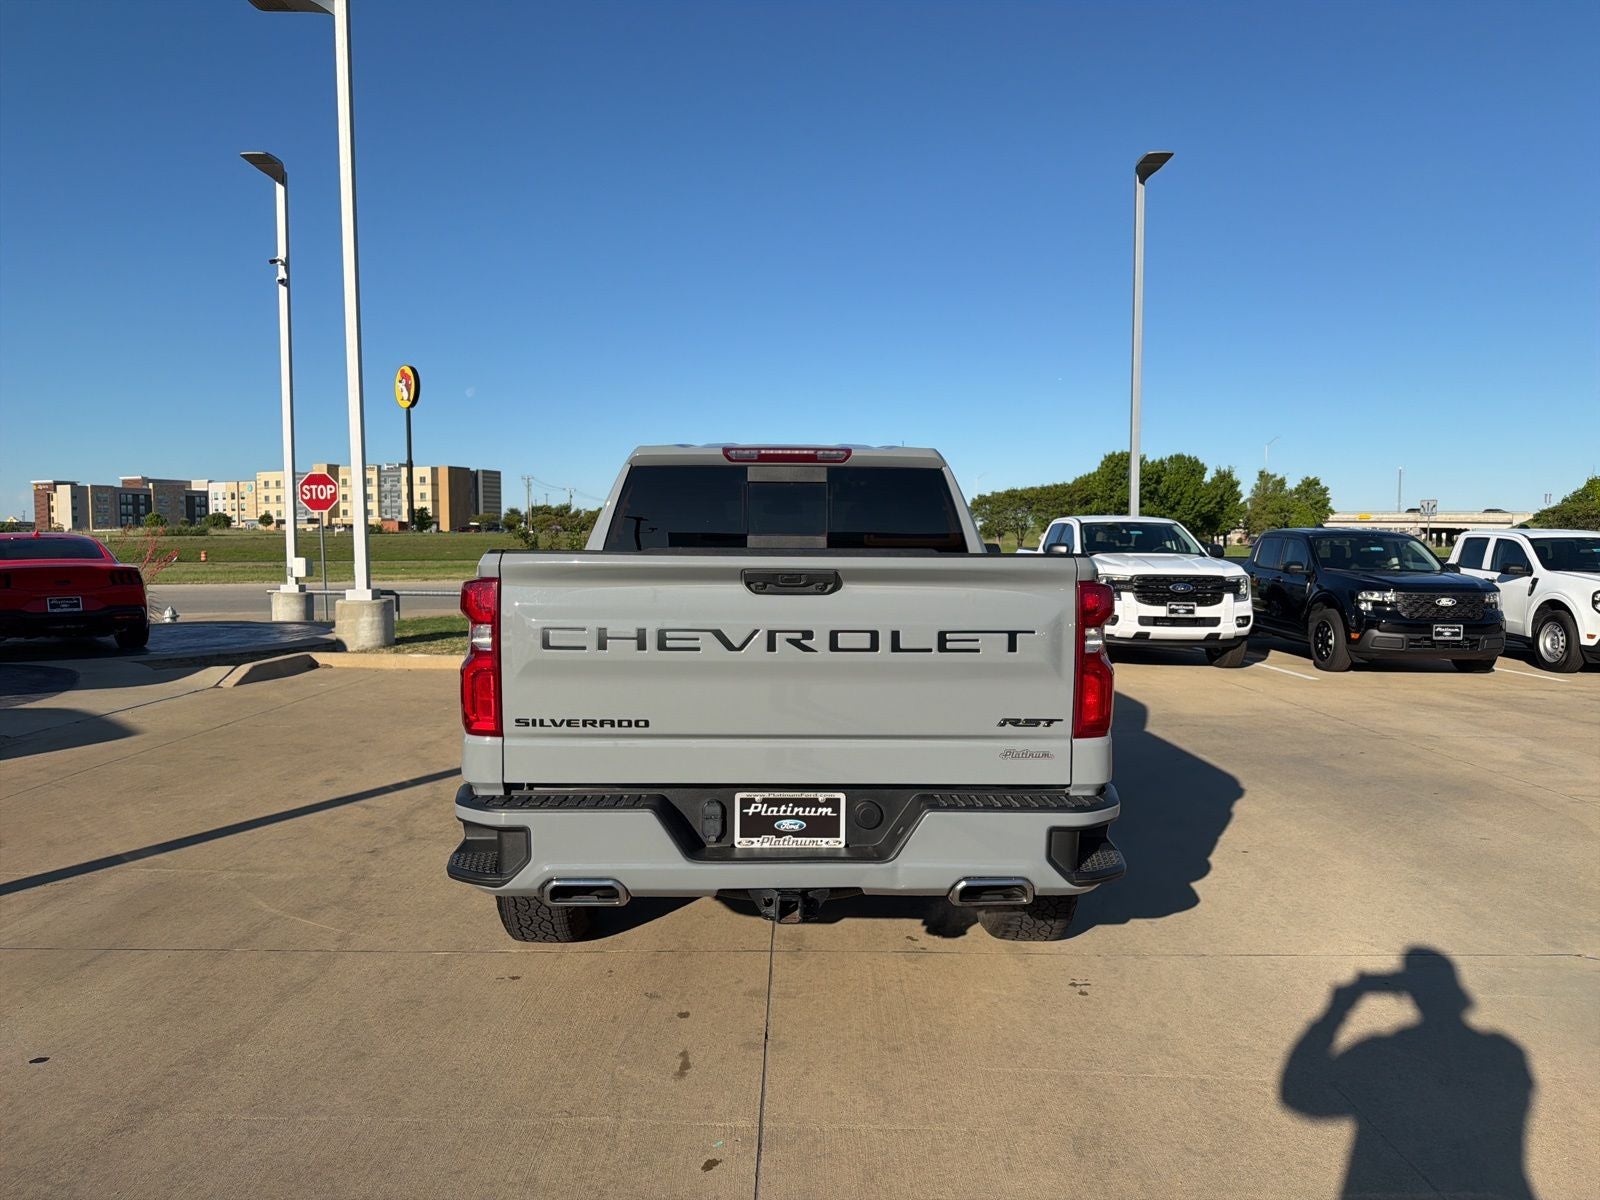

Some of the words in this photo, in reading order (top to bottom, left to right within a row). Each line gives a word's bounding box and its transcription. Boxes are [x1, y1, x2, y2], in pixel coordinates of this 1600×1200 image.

[301, 484, 336, 500] STOP
[540, 628, 1037, 654] CHEVROLET
[514, 718, 650, 728] SILVERADO
[996, 717, 1064, 728] RST
[998, 748, 1056, 761] Platinum
[742, 803, 838, 816] Platinum
[780, 821, 800, 831] Ford
[760, 835, 823, 847] Platinum
